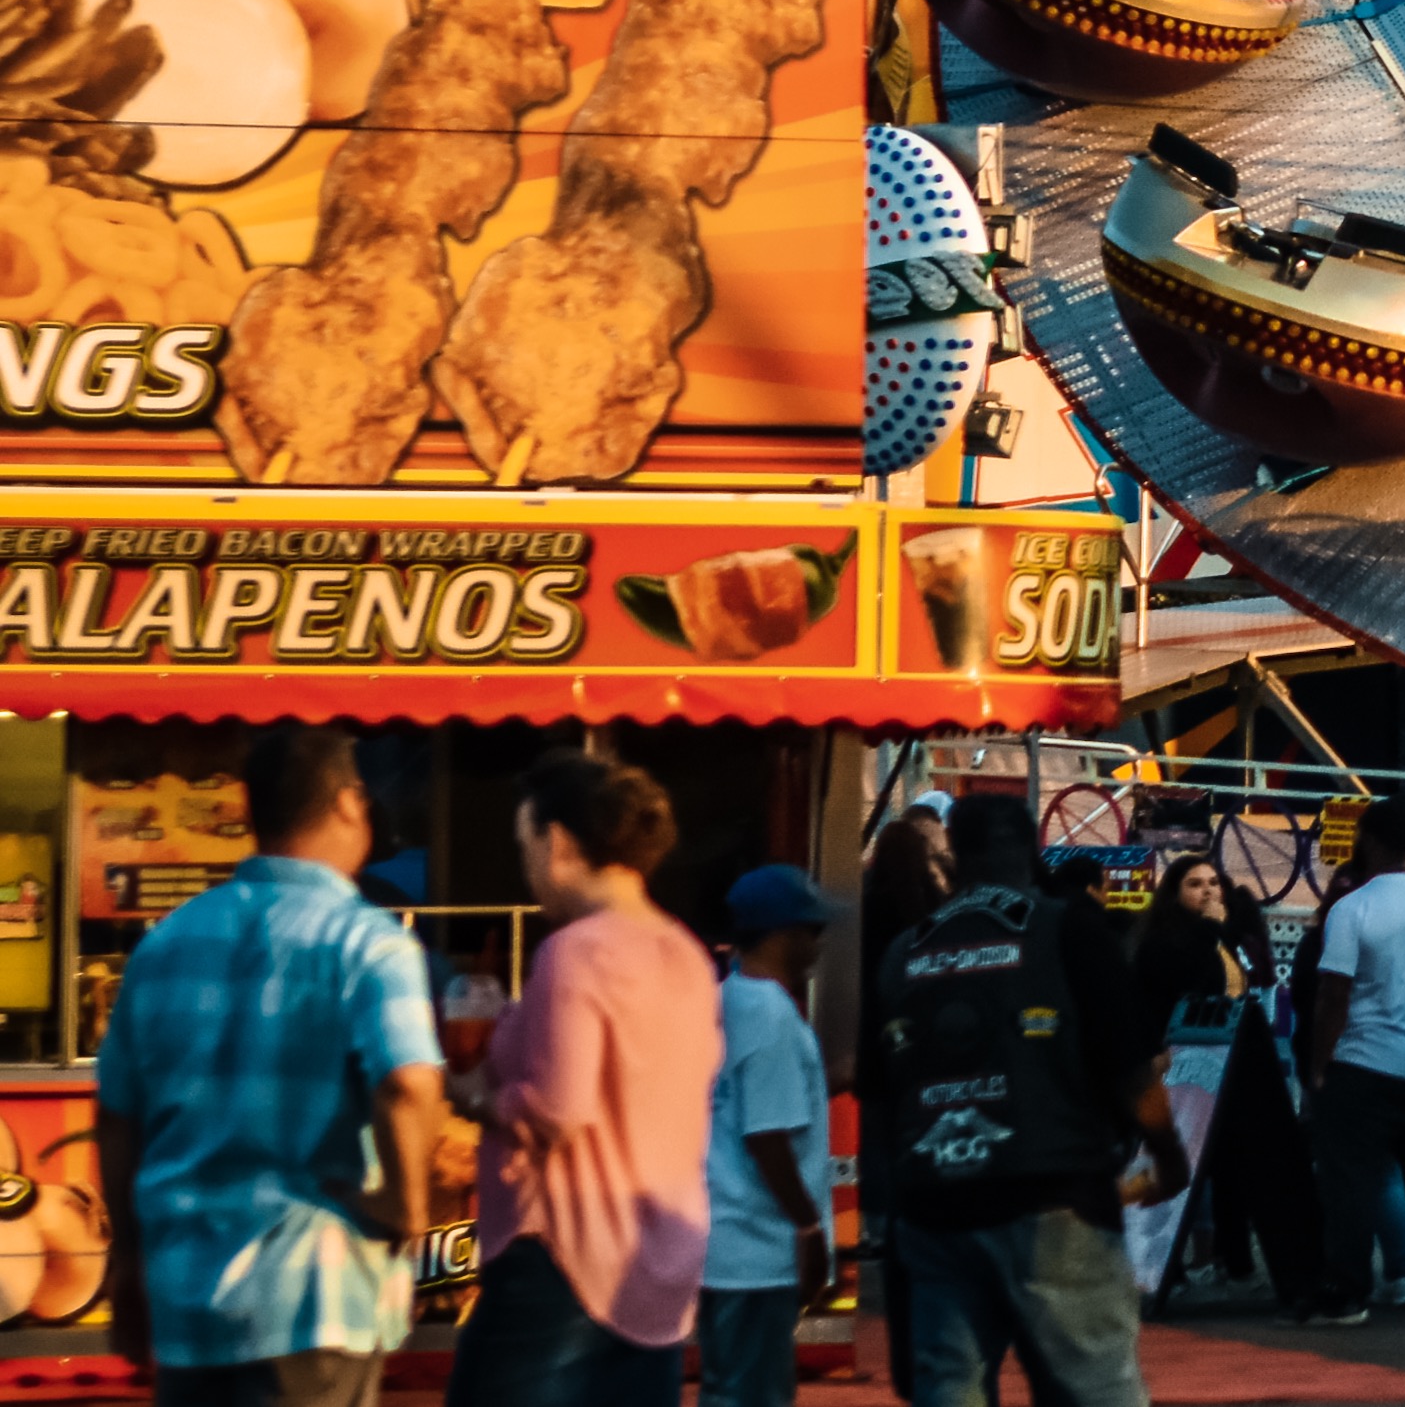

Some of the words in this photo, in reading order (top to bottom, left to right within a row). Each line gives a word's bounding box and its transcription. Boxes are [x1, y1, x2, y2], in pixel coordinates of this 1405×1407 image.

[0, 324, 216, 411] NGS
[0, 527, 74, 559] EEP
[81, 527, 210, 561] FRIED
[217, 528, 368, 562] BACON
[376, 529, 585, 563] WRAPPED
[1013, 534, 1069, 567] ICE
[0, 566, 578, 653] ALAPENOS
[933, 1135, 989, 1166] HOG
